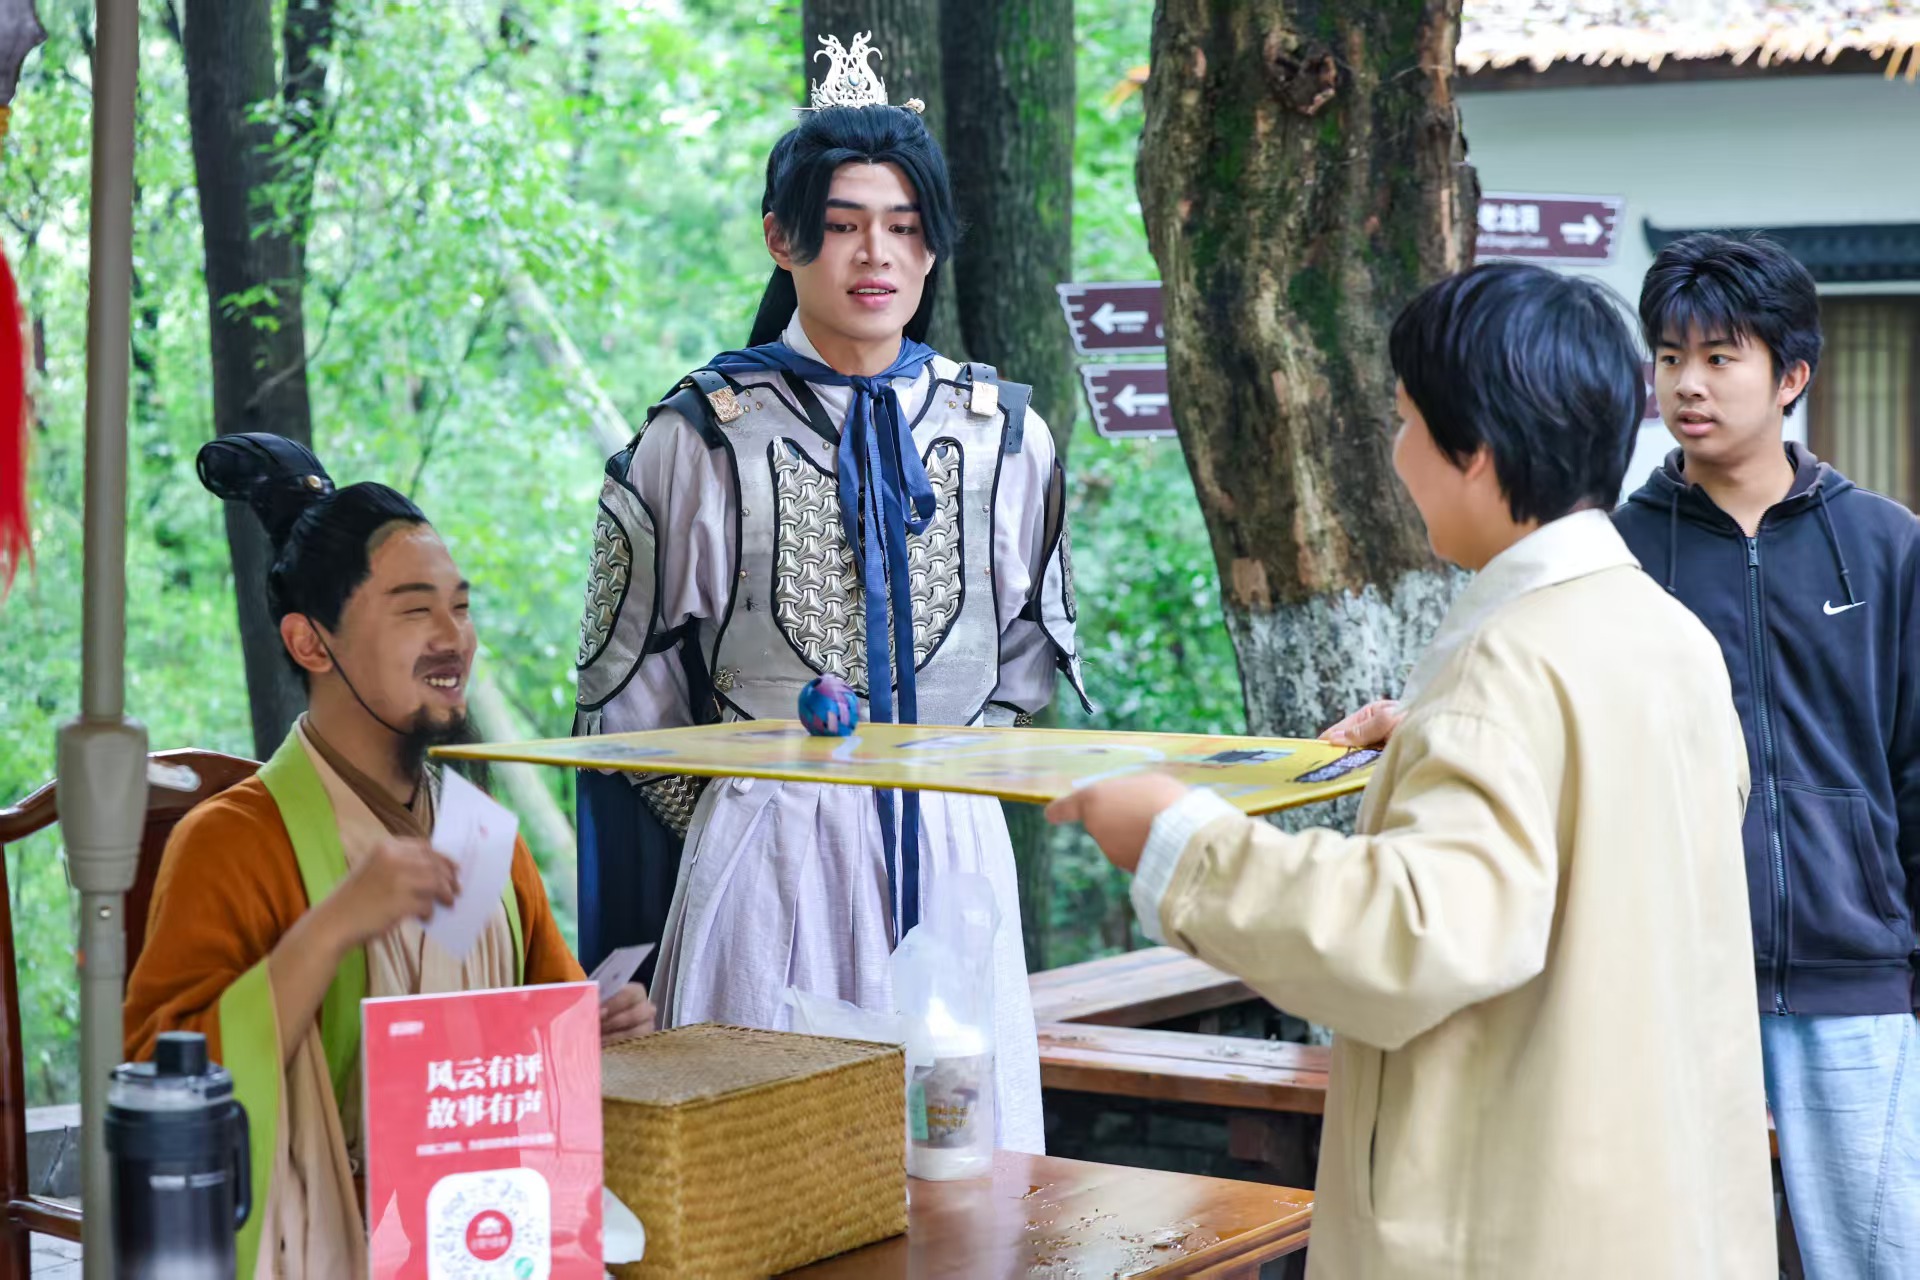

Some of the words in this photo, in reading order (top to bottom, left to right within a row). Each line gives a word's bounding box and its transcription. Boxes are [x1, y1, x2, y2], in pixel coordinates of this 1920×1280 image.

[427, 1053, 543, 1092] 风云有评
[427, 1090, 542, 1128] 故事有声
